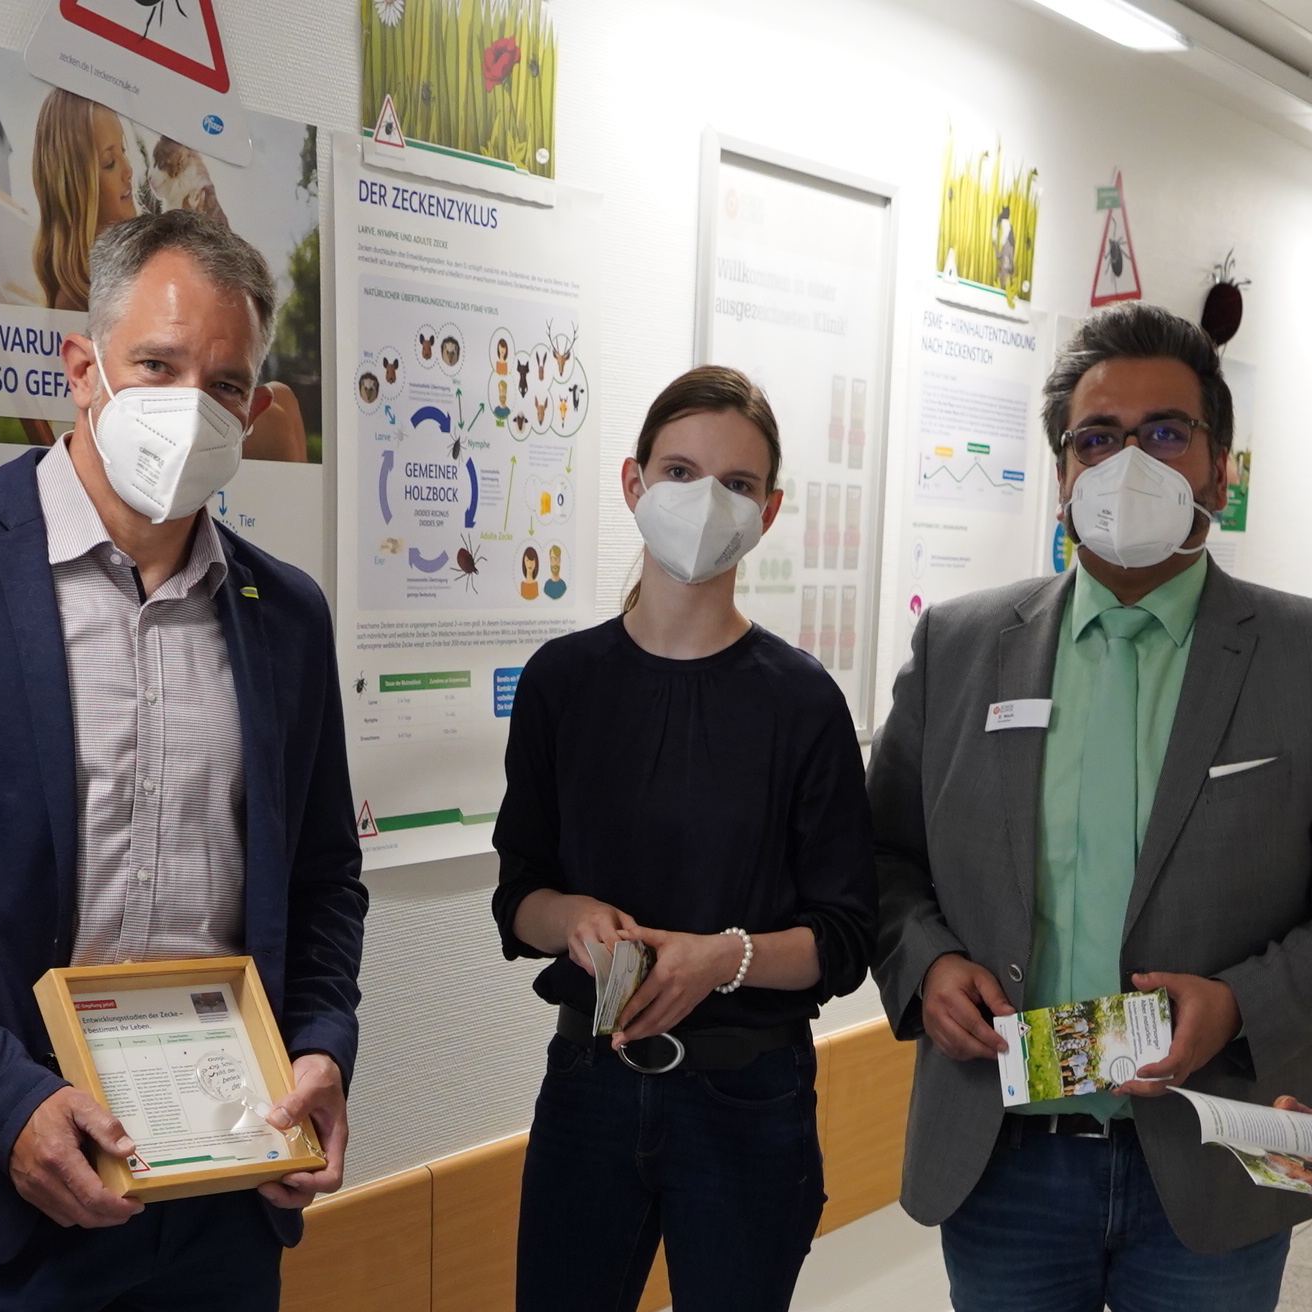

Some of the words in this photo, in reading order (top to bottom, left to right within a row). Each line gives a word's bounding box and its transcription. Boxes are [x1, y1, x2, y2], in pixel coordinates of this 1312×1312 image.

[359, 179, 387, 207] DER
[392, 187, 498, 229] ZECKENZYKLUS
[405, 462, 458, 480] GEMEINER
[405, 485, 458, 502] HOLZBOCK
[239, 514, 255, 527] Tier
